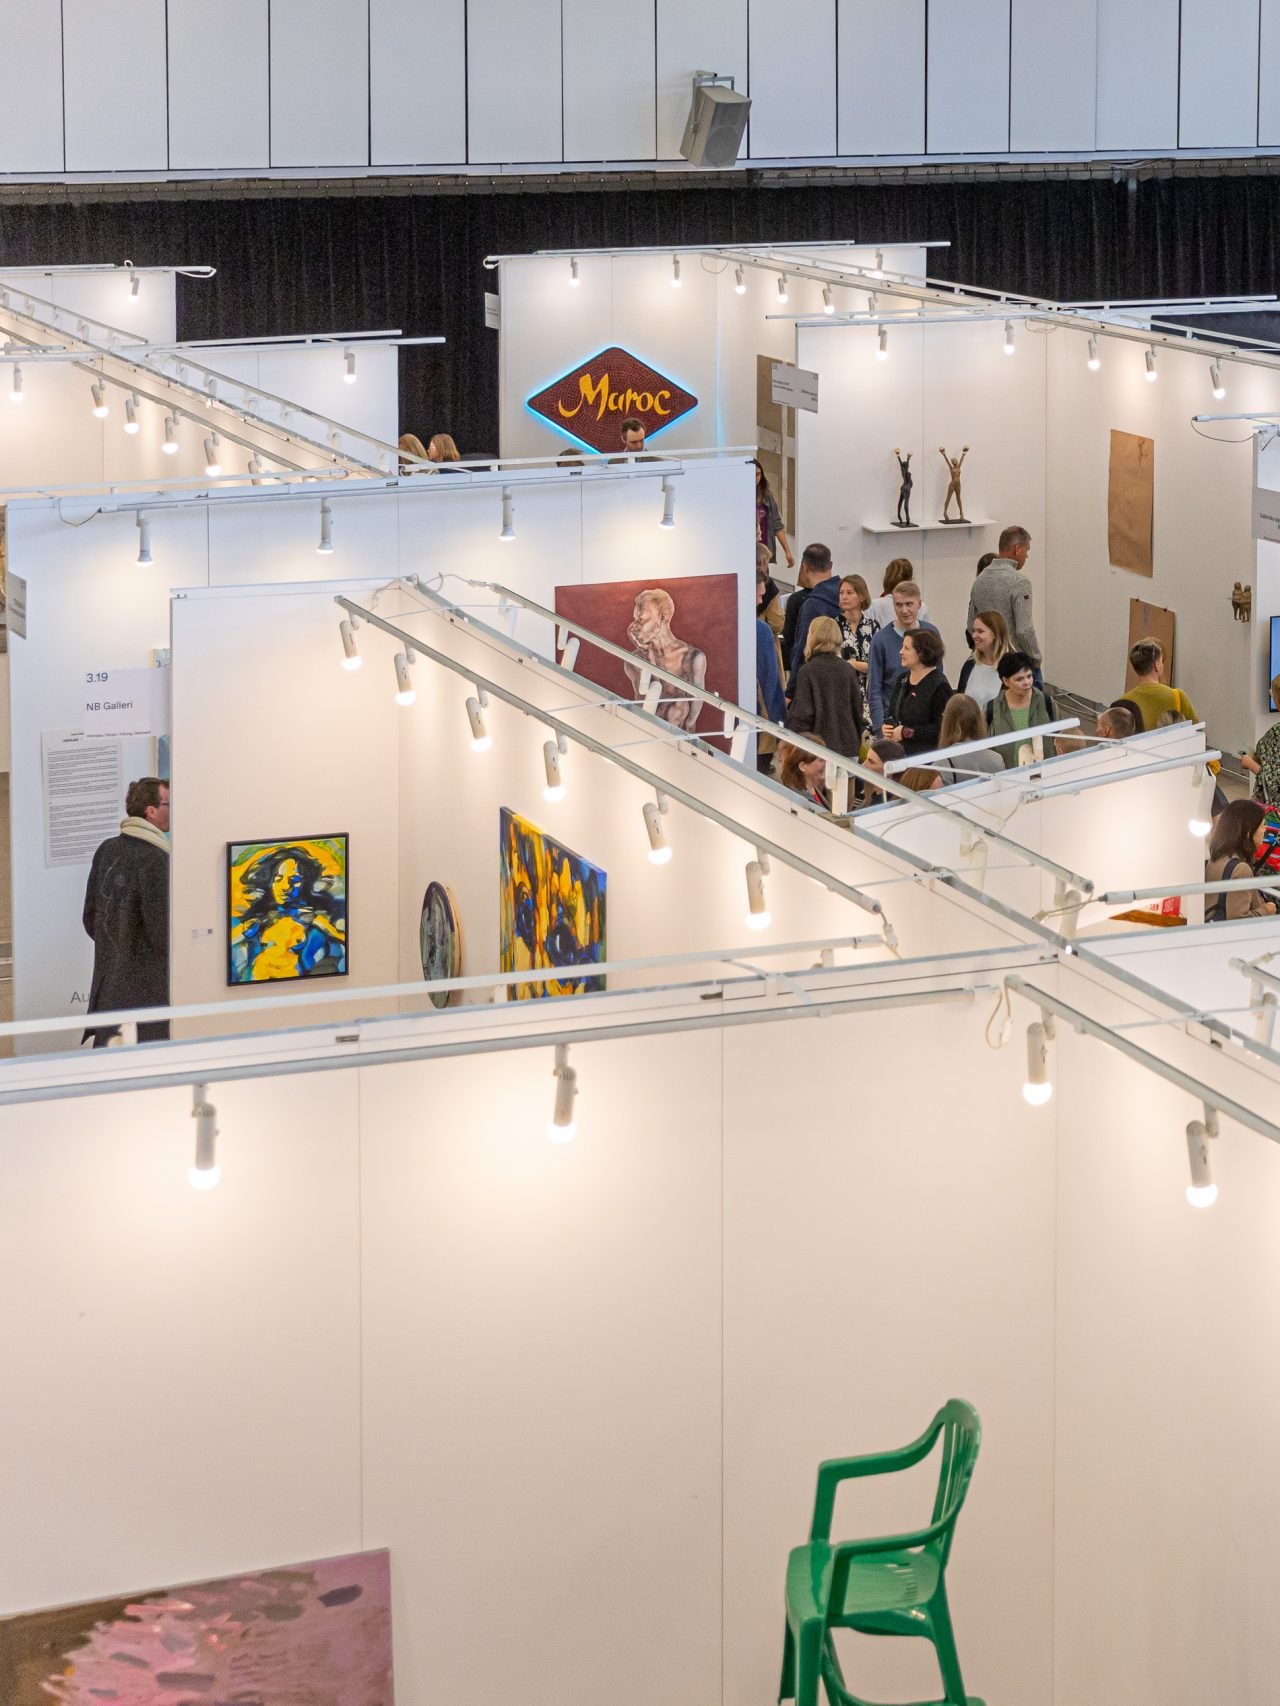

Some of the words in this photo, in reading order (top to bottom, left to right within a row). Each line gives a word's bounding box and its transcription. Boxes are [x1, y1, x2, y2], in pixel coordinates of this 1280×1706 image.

[558, 372, 672, 422] Maroc
[86, 672, 108, 683] 3.19
[86, 702, 101, 711] NB
[103, 701, 133, 710] Galleri
[70, 991, 90, 1004] Au
